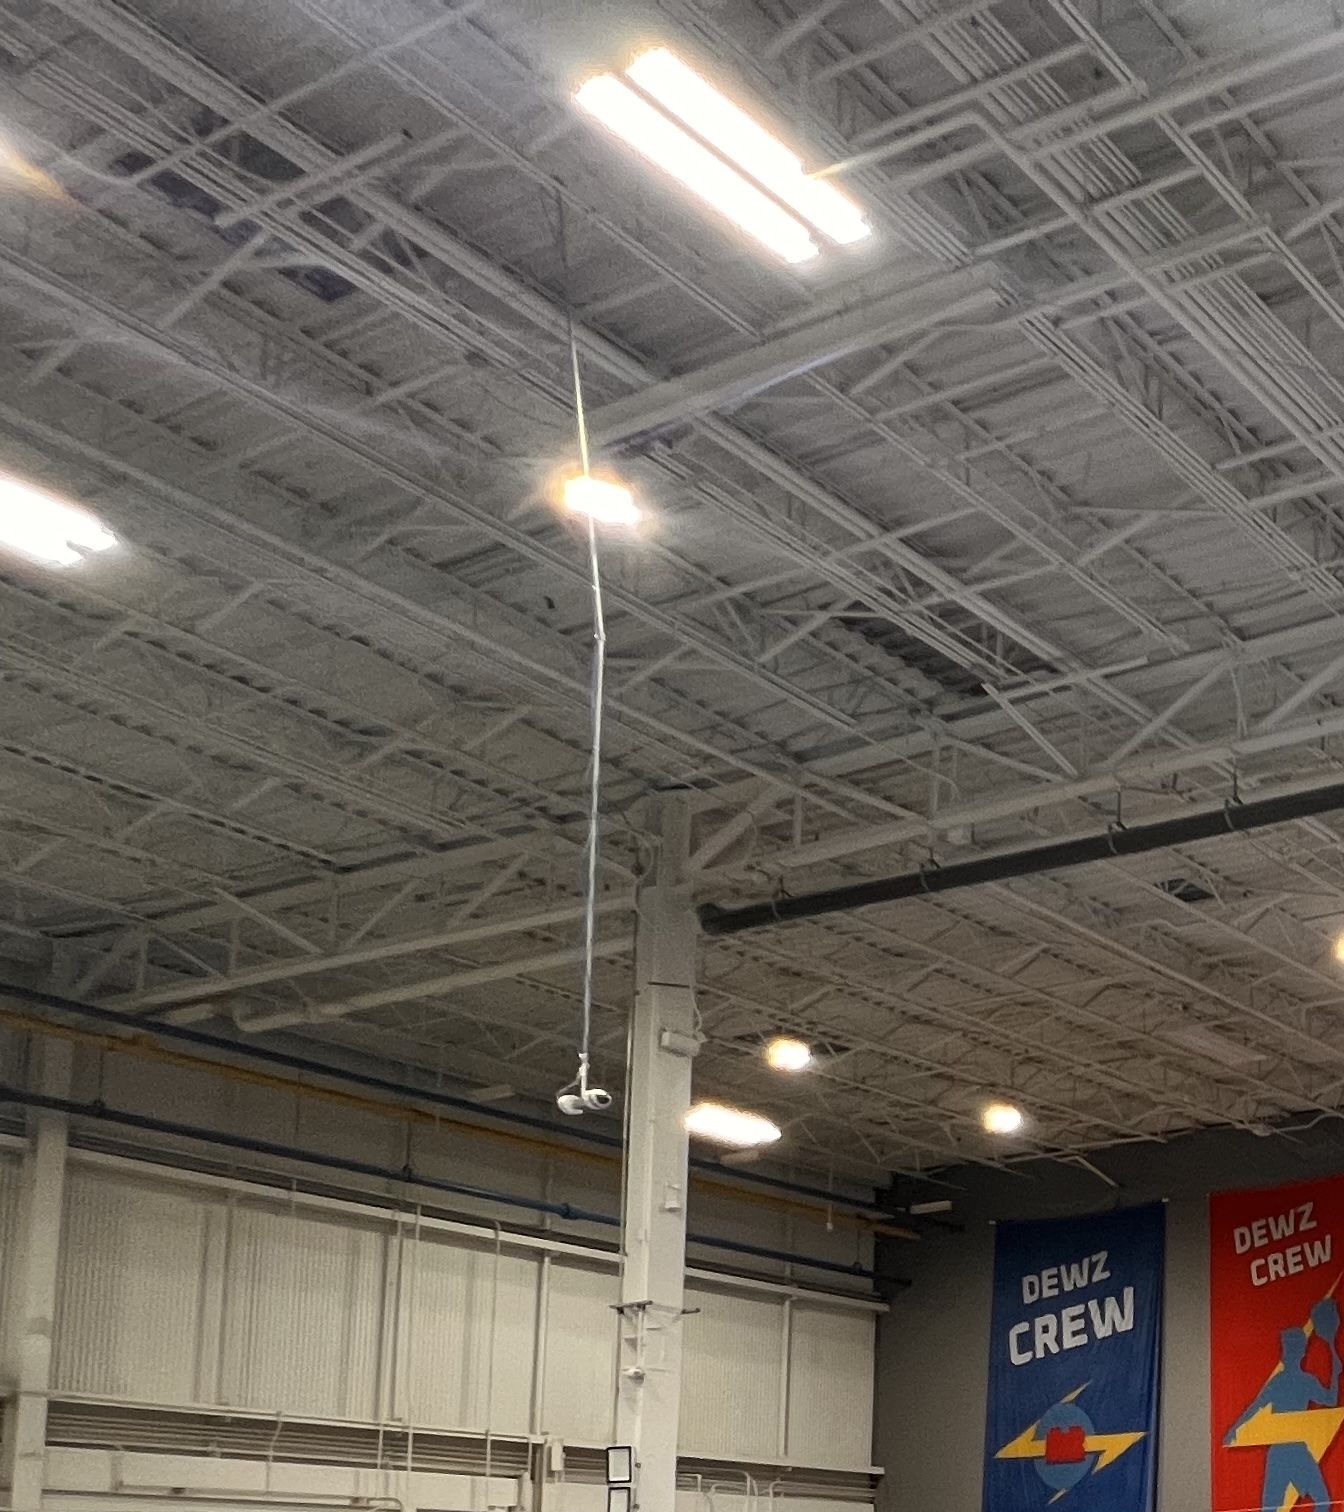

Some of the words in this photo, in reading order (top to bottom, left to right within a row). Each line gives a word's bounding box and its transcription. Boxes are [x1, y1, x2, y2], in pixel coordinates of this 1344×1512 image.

[1233, 1201, 1318, 1255] DEWZ
[1022, 1251, 1112, 1305] DEWZ
[1250, 1234, 1333, 1287] CREW
[1008, 1286, 1135, 1366] CREW
